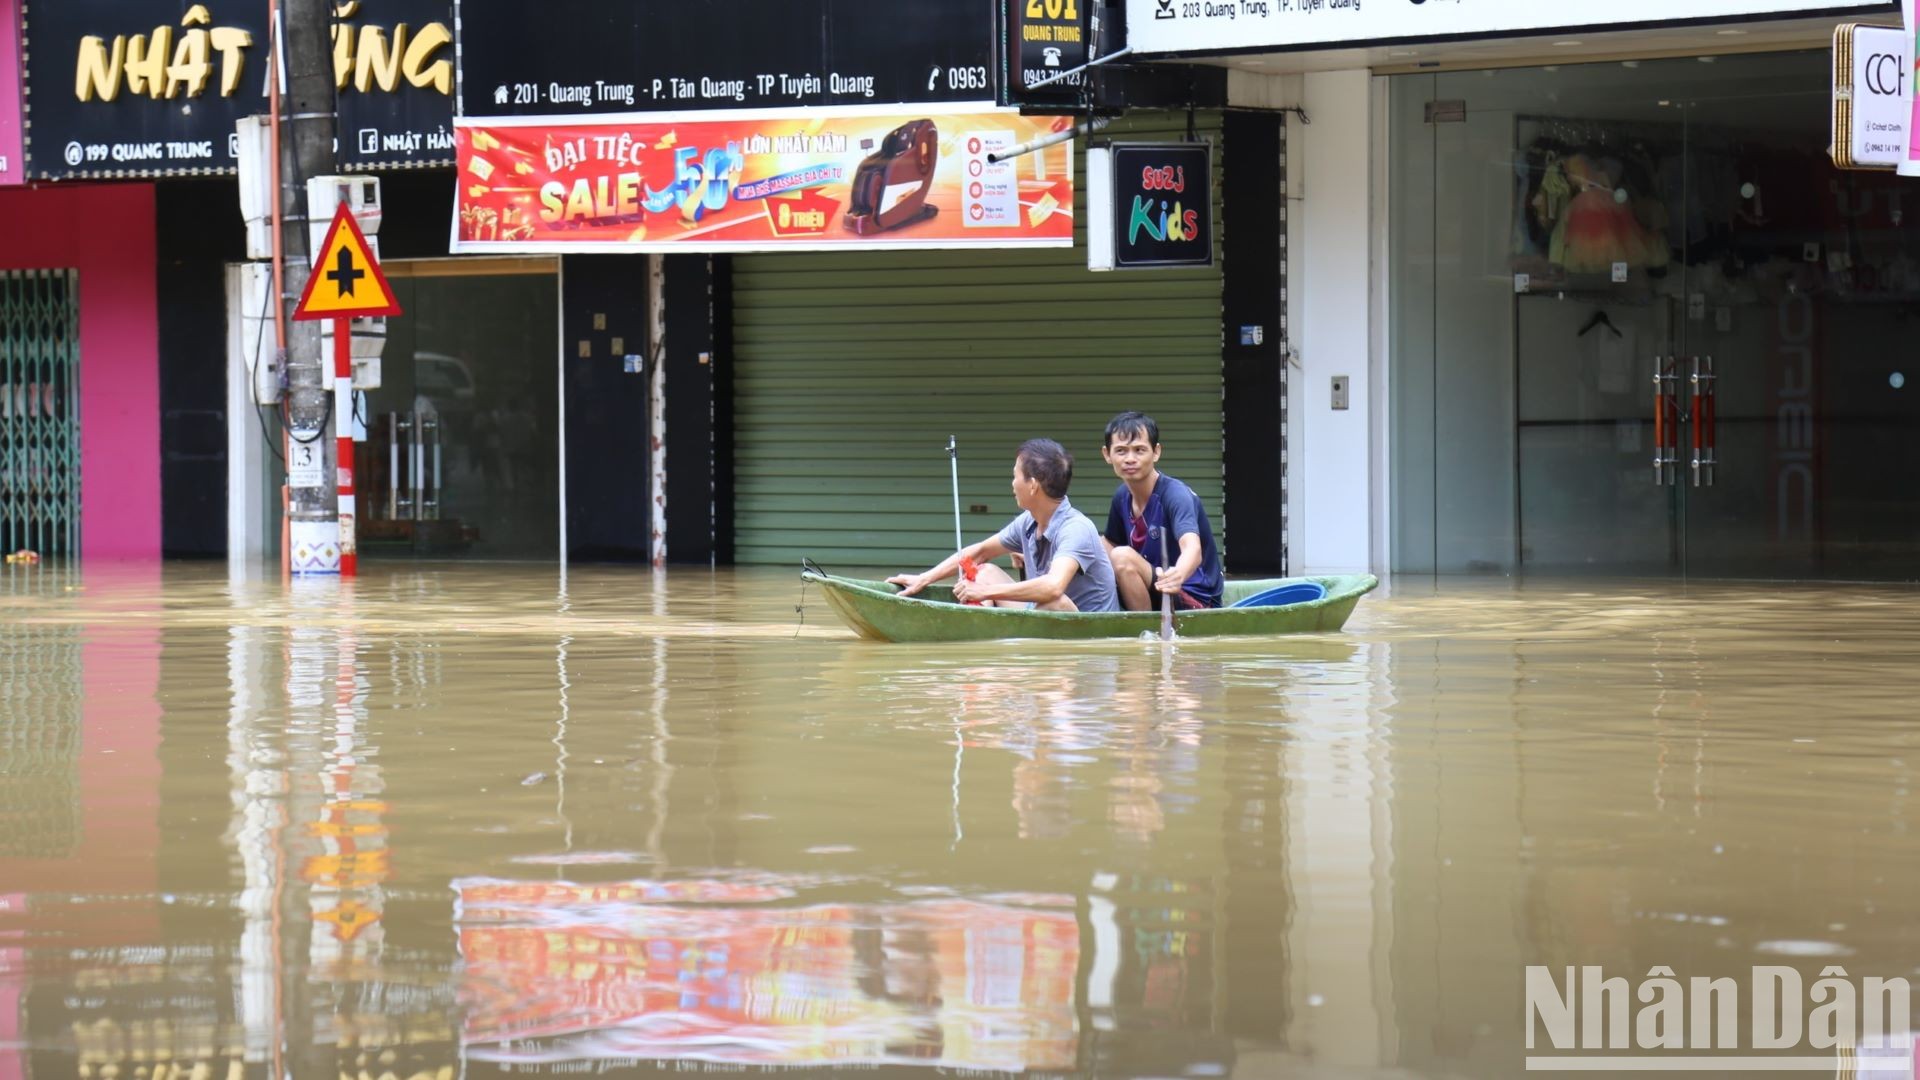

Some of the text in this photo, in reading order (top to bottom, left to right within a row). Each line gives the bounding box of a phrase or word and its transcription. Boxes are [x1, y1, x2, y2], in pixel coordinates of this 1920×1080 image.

[1183, 2, 1200, 18] 203
[1205, 1, 1235, 20] Quang
[1240, 0, 1270, 18] Trung,
[1023, 25, 1081, 42] QUANG TRUNG
[514, 83, 538, 104] 201
[549, 82, 592, 106] Quang
[595, 81, 634, 105] Trung
[652, 79, 666, 99] P.
[670, 78, 695, 98] Tân
[701, 77, 745, 101] Quang
[756, 74, 775, 95] TP
[779, 73, 821, 99] Tuyên
[830, 73, 874, 97] Quang
[949, 67, 987, 90] 0963
[85, 141, 212, 162] 199 QUANG TRUNG
[383, 130, 422, 155] NHẬT
[592, 132, 647, 168] TIỆC
[539, 172, 645, 223] SALE
[1129, 194, 1198, 246] Kids
